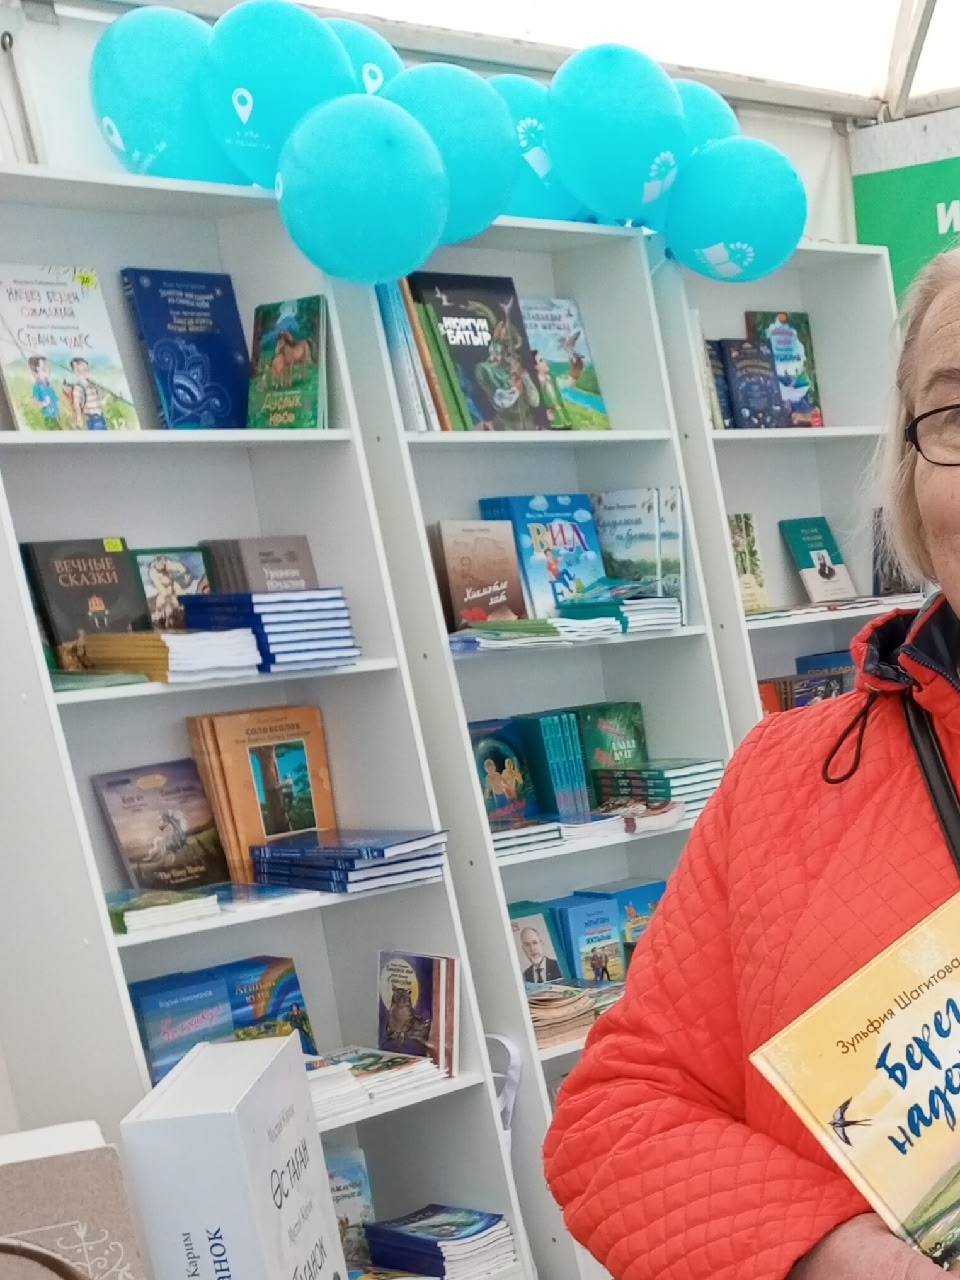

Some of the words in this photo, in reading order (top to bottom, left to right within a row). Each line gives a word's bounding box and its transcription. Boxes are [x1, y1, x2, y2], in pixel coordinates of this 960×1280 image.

[446, 330, 491, 346] БАТЫР
[54, 557, 115, 575] ВЕЧНЫЕ
[58, 571, 118, 588] СКАЗКИ
[836, 1008, 896, 1054] Зульфия
[182, 1232, 200, 1279] Карим
